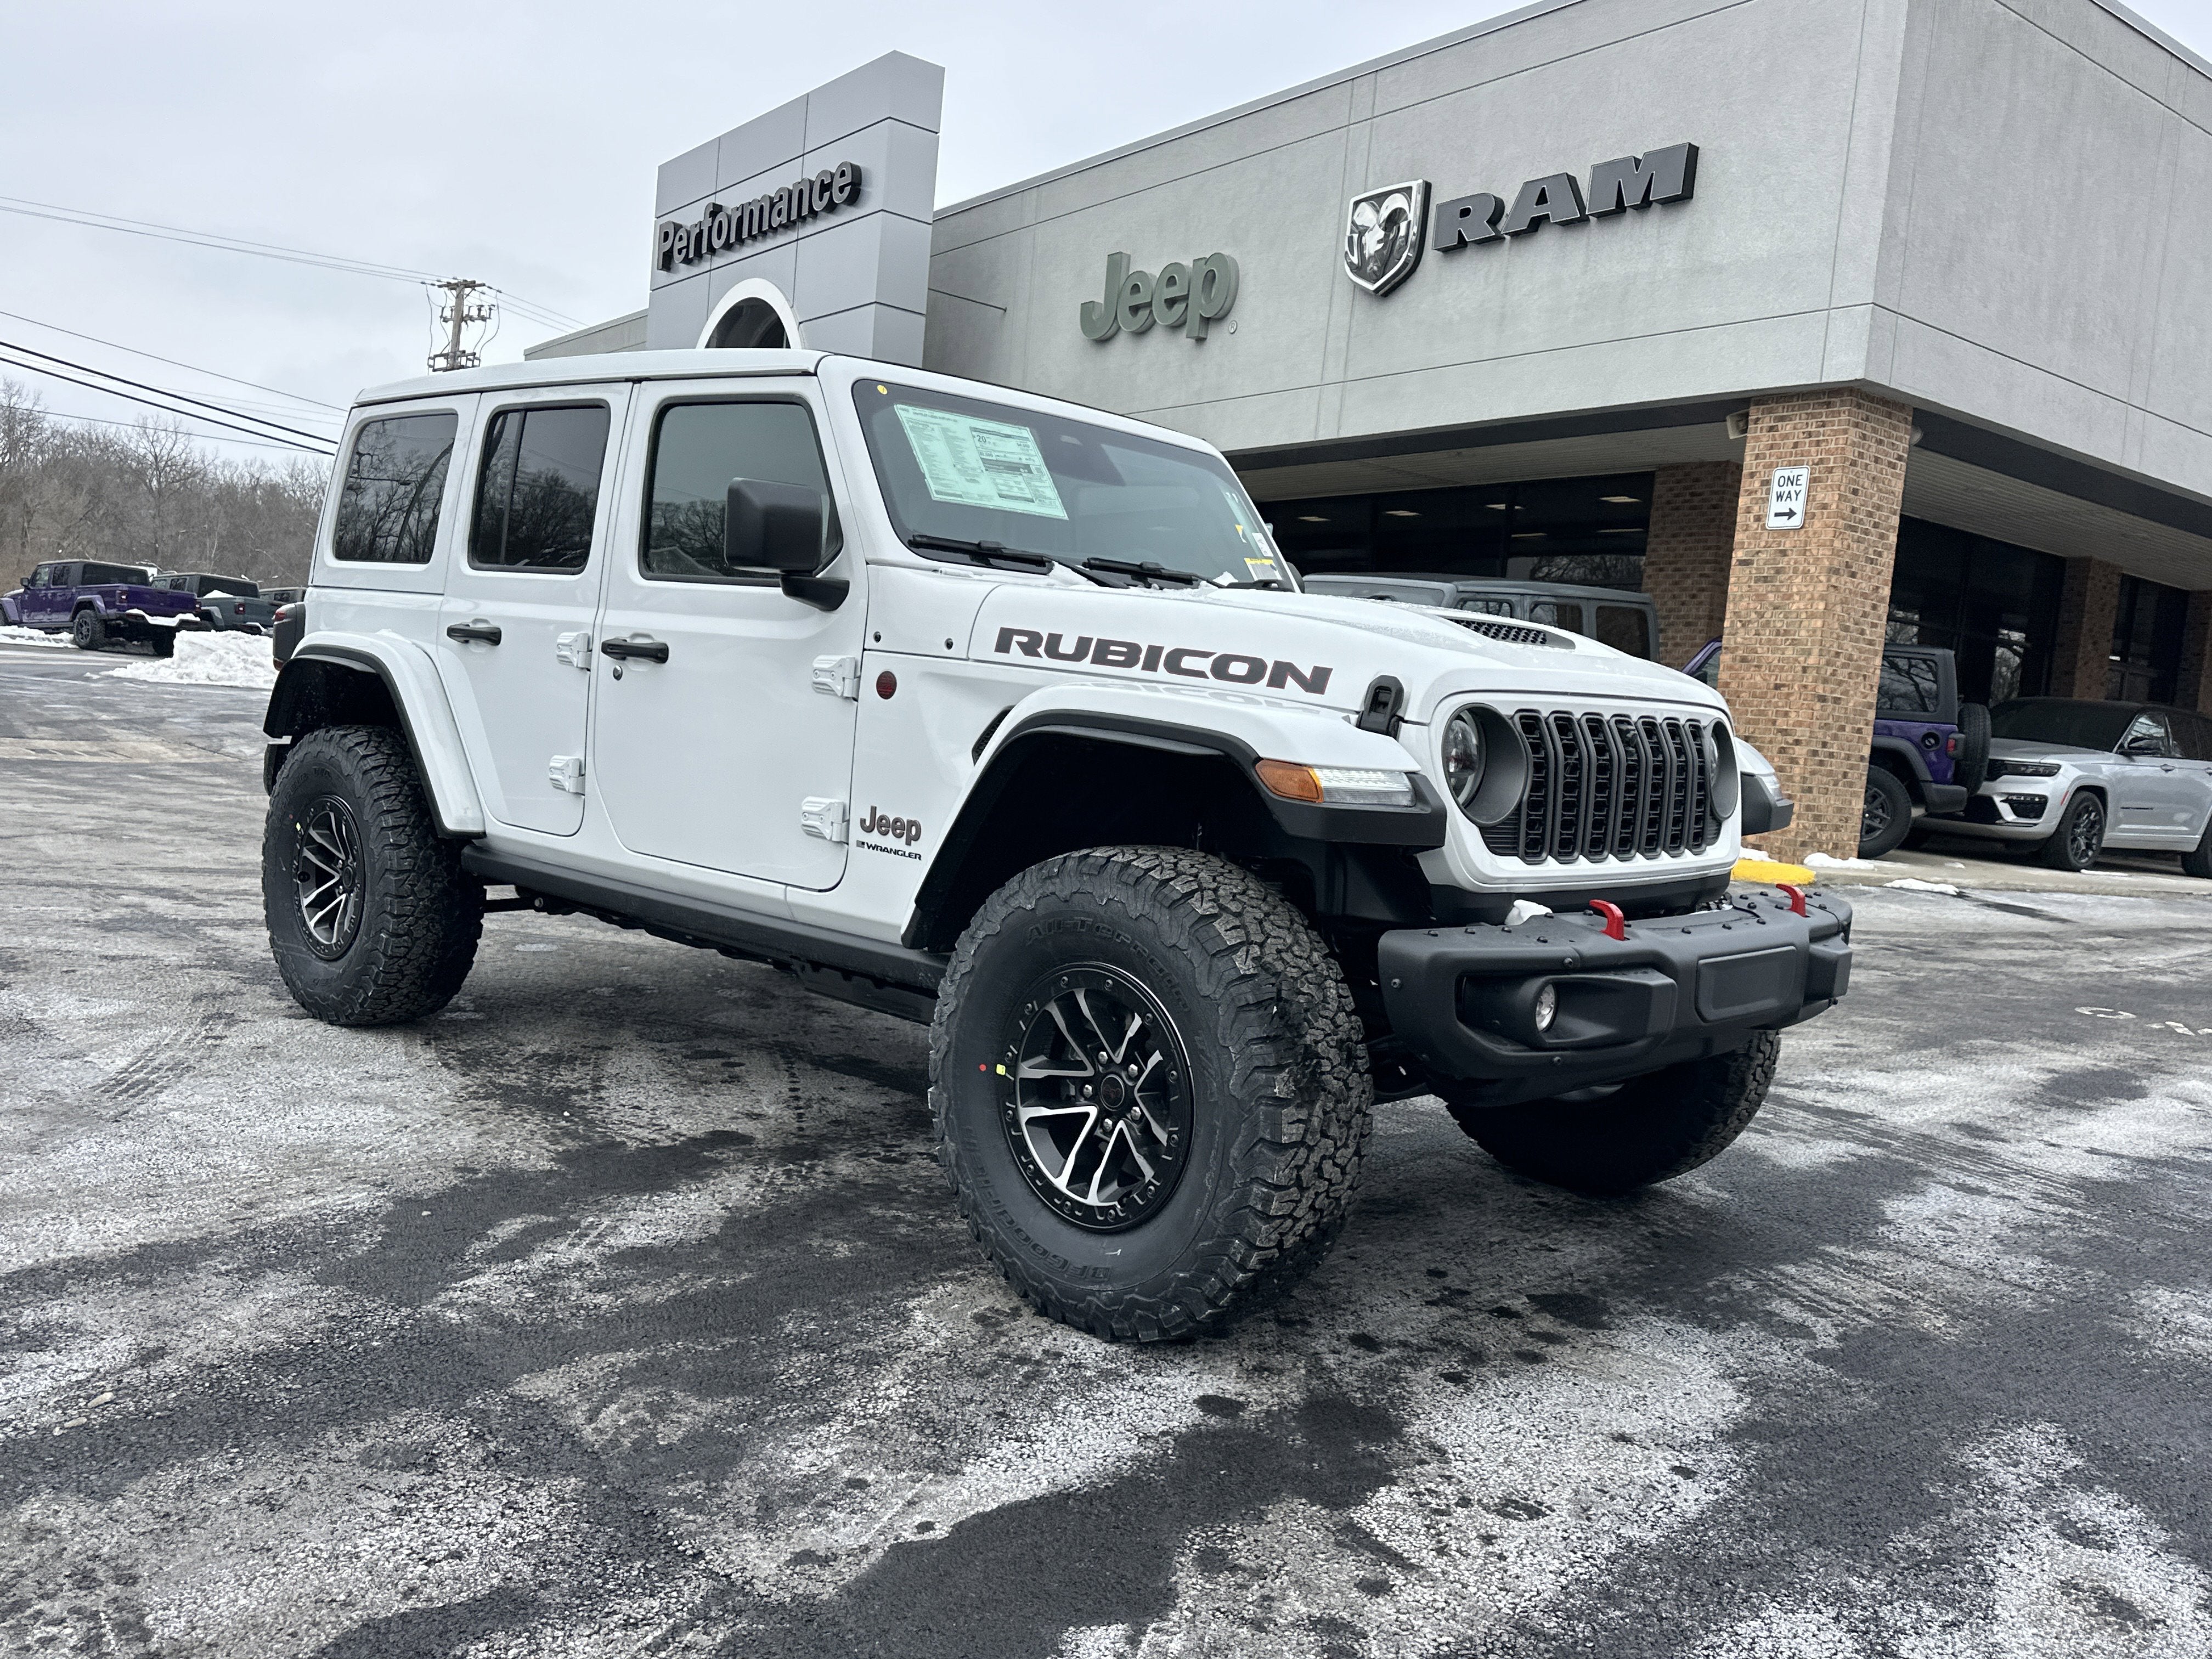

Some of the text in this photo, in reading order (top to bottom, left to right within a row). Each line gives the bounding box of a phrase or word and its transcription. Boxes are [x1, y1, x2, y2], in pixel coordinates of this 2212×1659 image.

[657, 160, 862, 272] Performance
[1431, 142, 1699, 252] RAM
[1080, 251, 1239, 340] Jeep
[1776, 489, 1802, 502] WAY
[1778, 474, 1803, 487] ONE
[994, 627, 1333, 696] RUBICON
[860, 805, 922, 846] Jeep
[866, 842, 922, 860] WRANGLER
